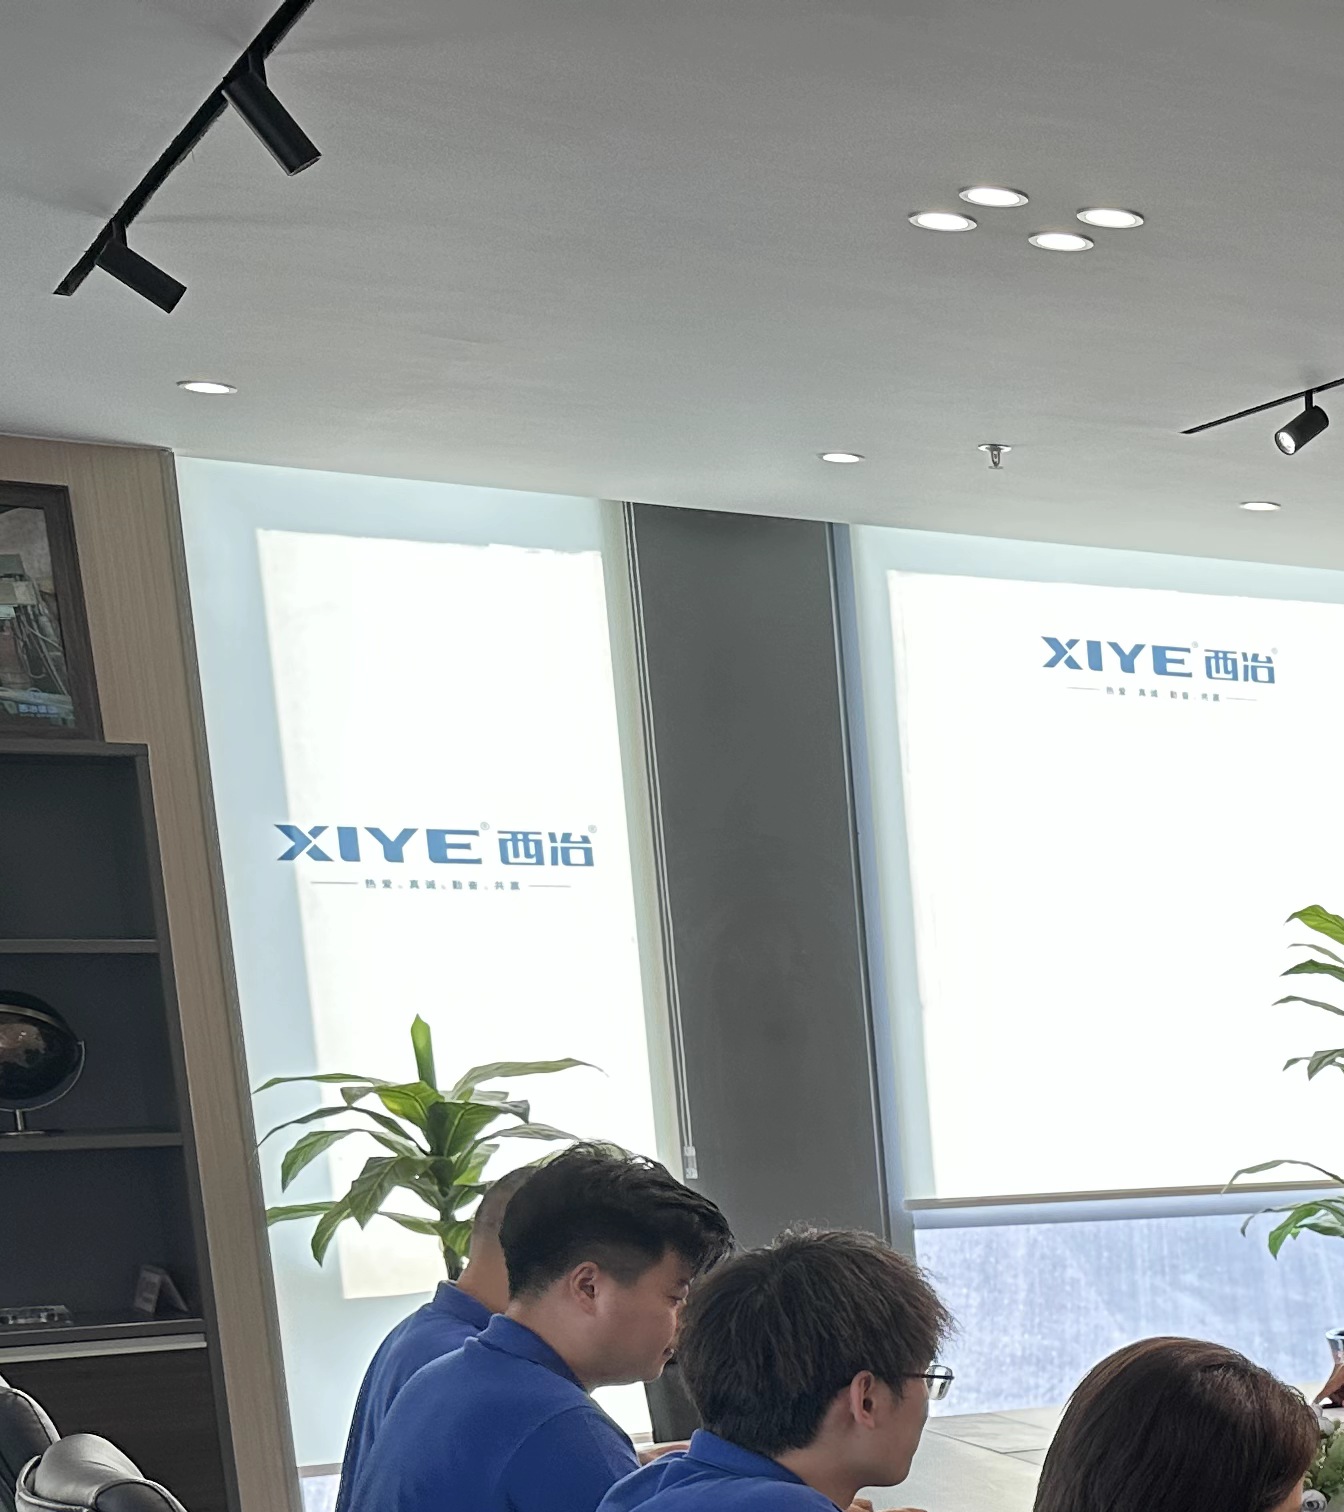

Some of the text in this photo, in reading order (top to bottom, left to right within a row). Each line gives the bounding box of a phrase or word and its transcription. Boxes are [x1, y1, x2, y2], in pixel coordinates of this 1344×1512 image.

[1041, 636, 1275, 684] XIYE 西冶
[274, 824, 595, 867] XIYE 西冶
